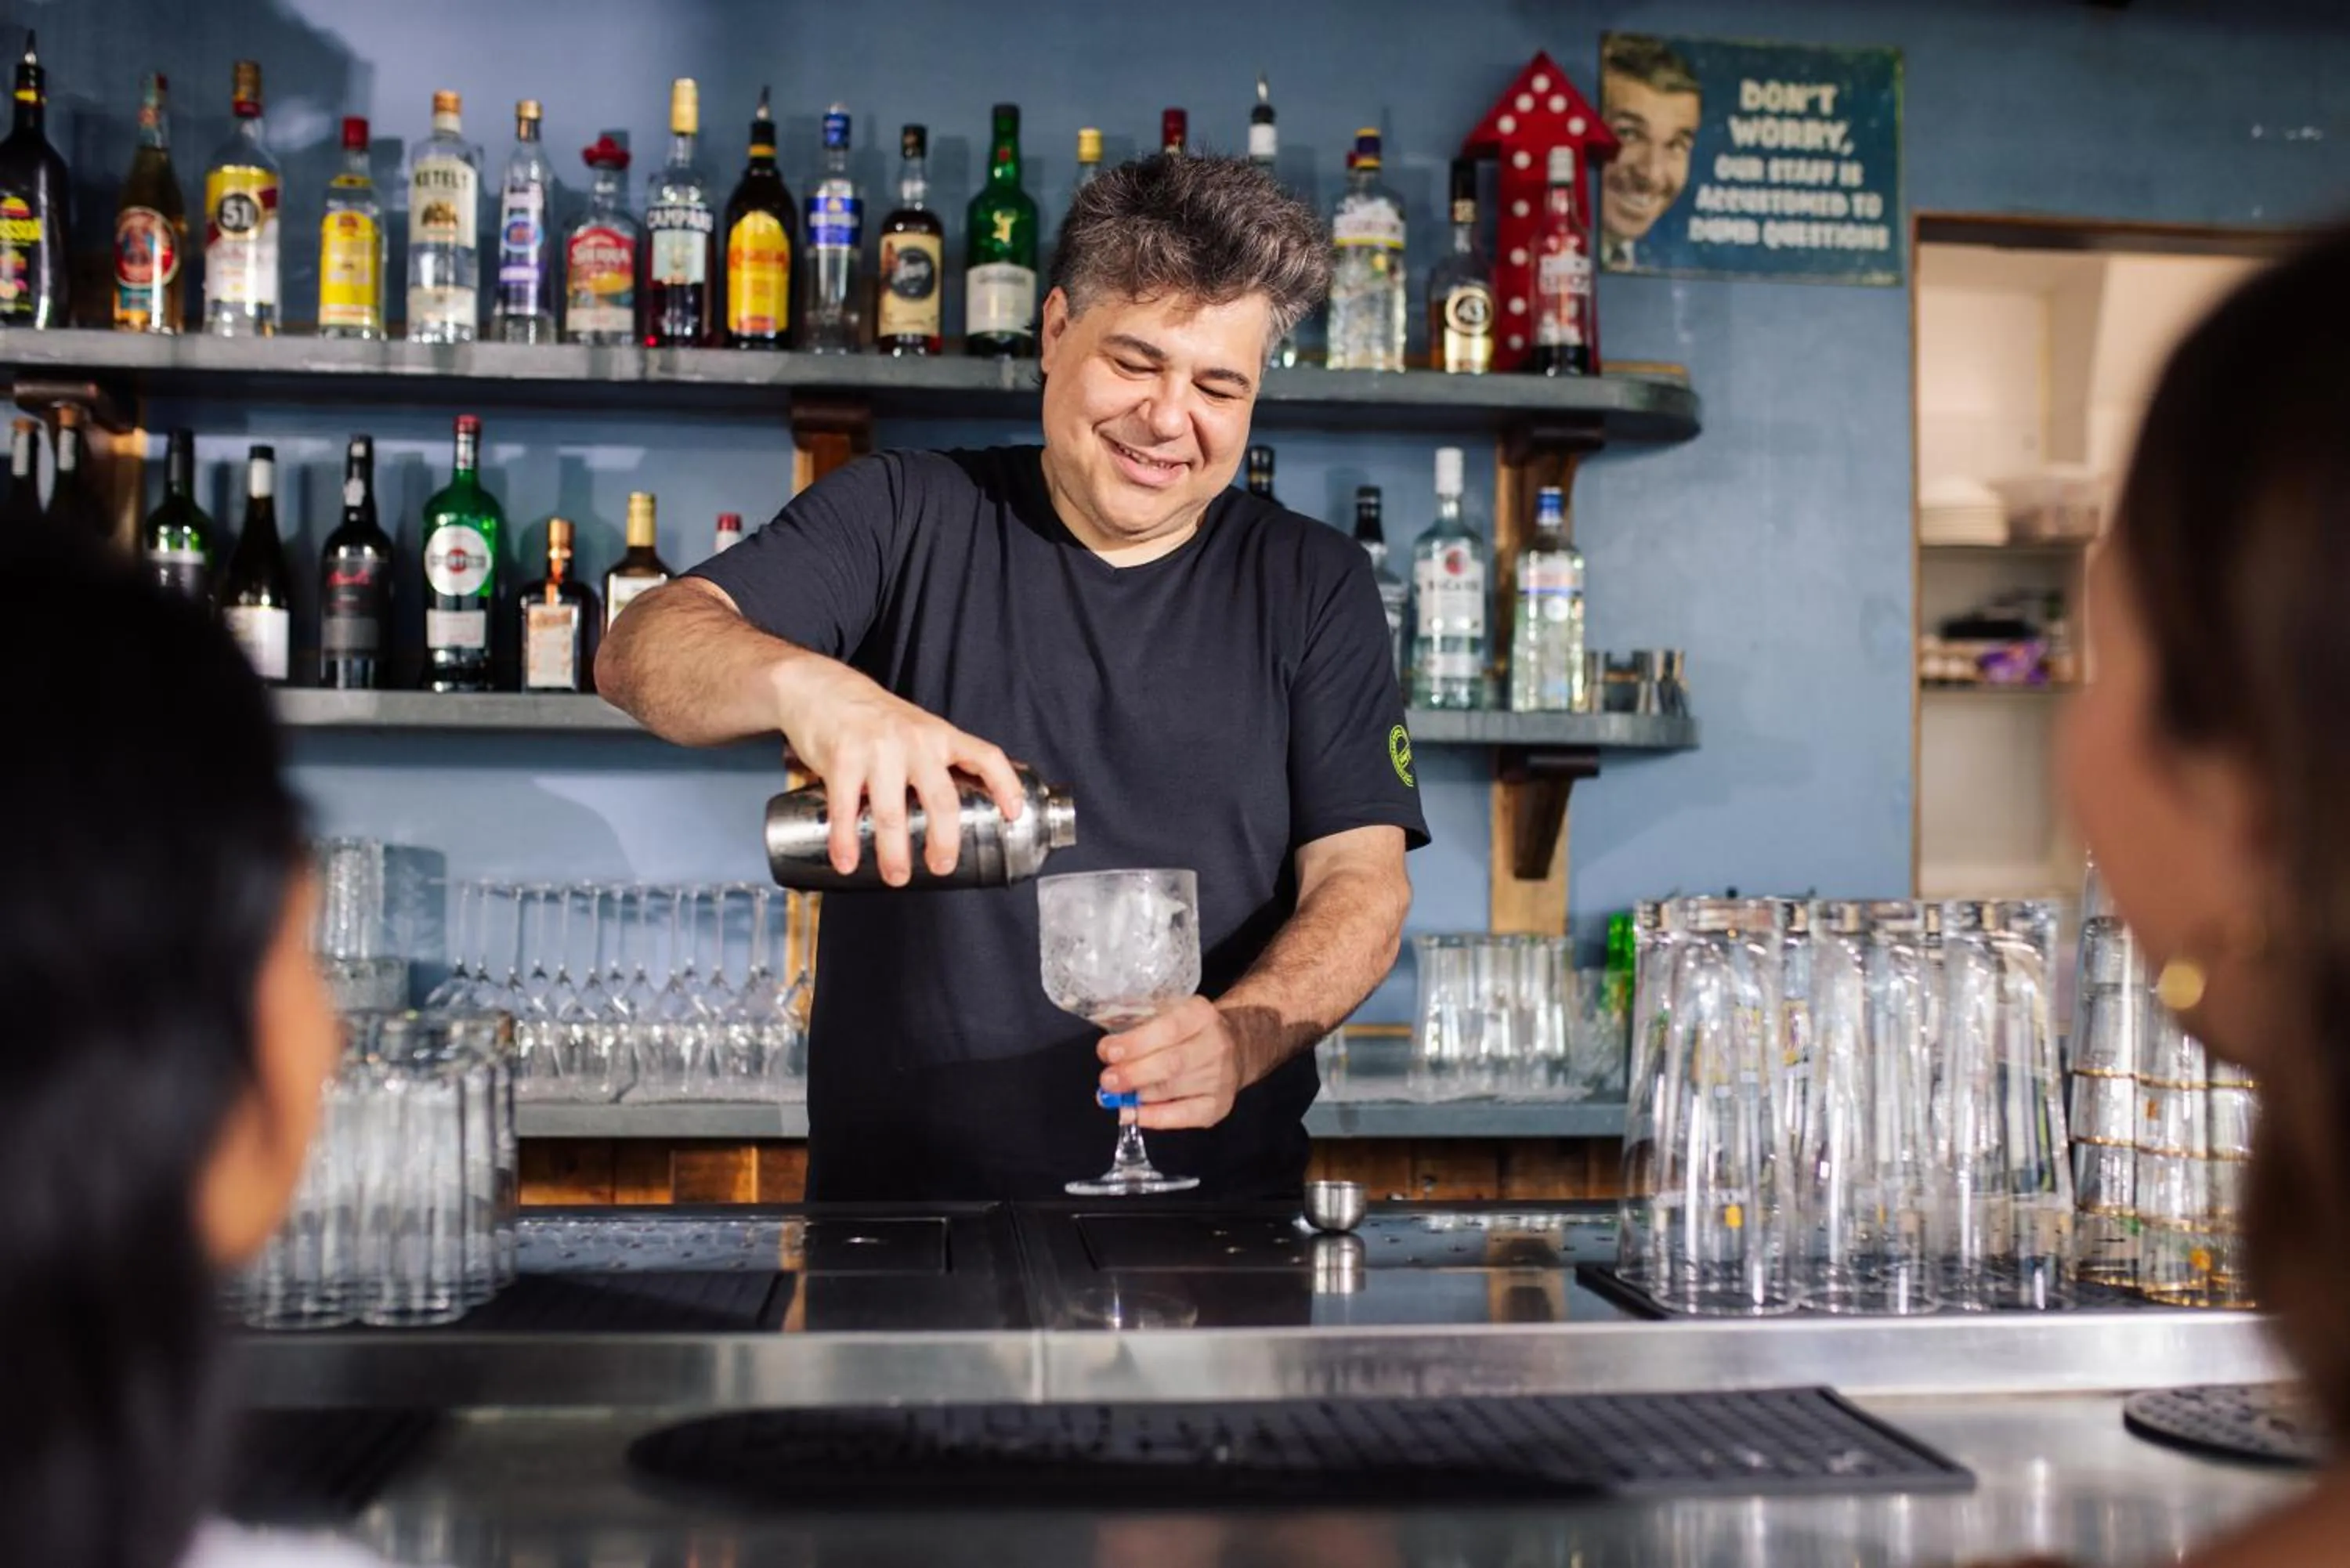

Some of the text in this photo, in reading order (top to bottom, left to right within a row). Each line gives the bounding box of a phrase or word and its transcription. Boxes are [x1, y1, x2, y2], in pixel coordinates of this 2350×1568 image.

[1739, 79, 1838, 116] DON'T
[1728, 114, 1854, 156] WORRY,
[1714, 154, 1763, 182] OUR
[1767, 157, 1835, 185] STAFF
[222, 198, 255, 229] 51
[1695, 183, 1883, 219] ACCUSTOMED TO
